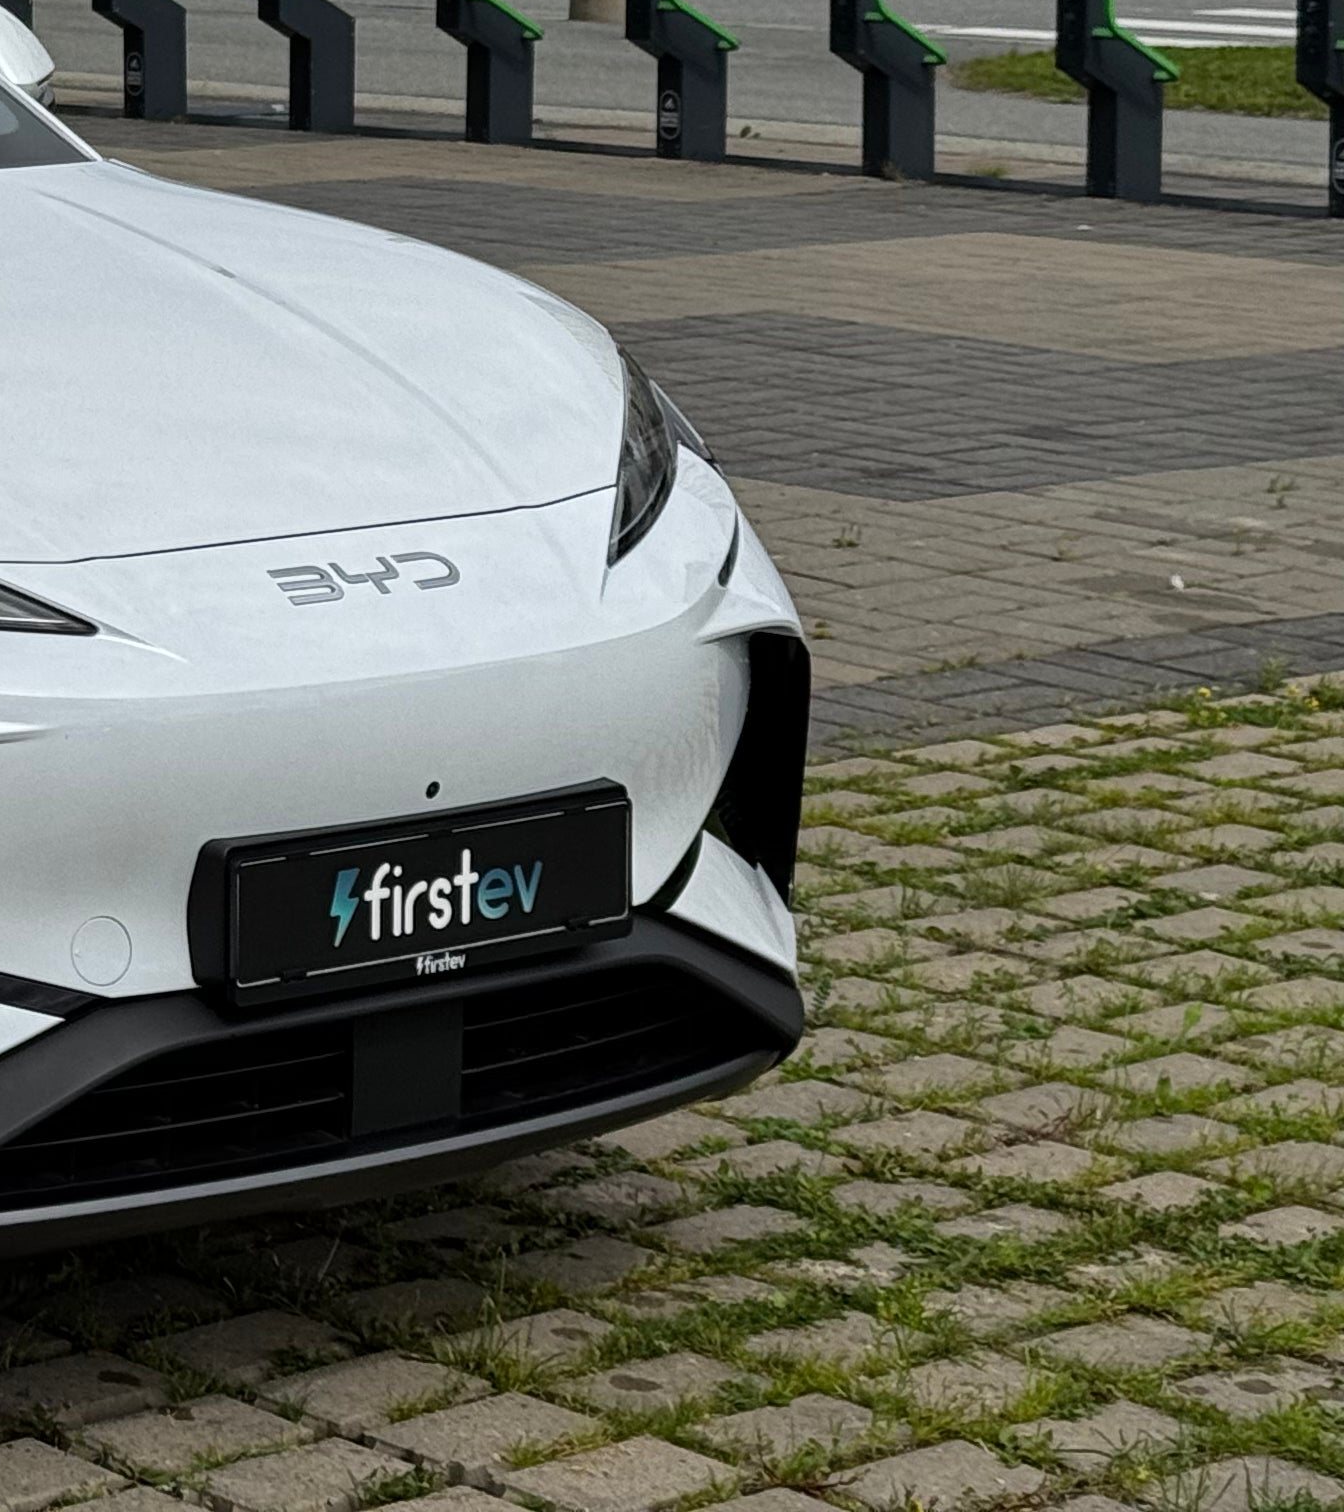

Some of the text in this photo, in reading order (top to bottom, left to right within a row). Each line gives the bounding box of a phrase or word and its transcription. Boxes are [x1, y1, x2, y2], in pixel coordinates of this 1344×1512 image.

[266, 551, 461, 606] BYD
[363, 848, 543, 942] firstev
[424, 951, 466, 975] firstev
